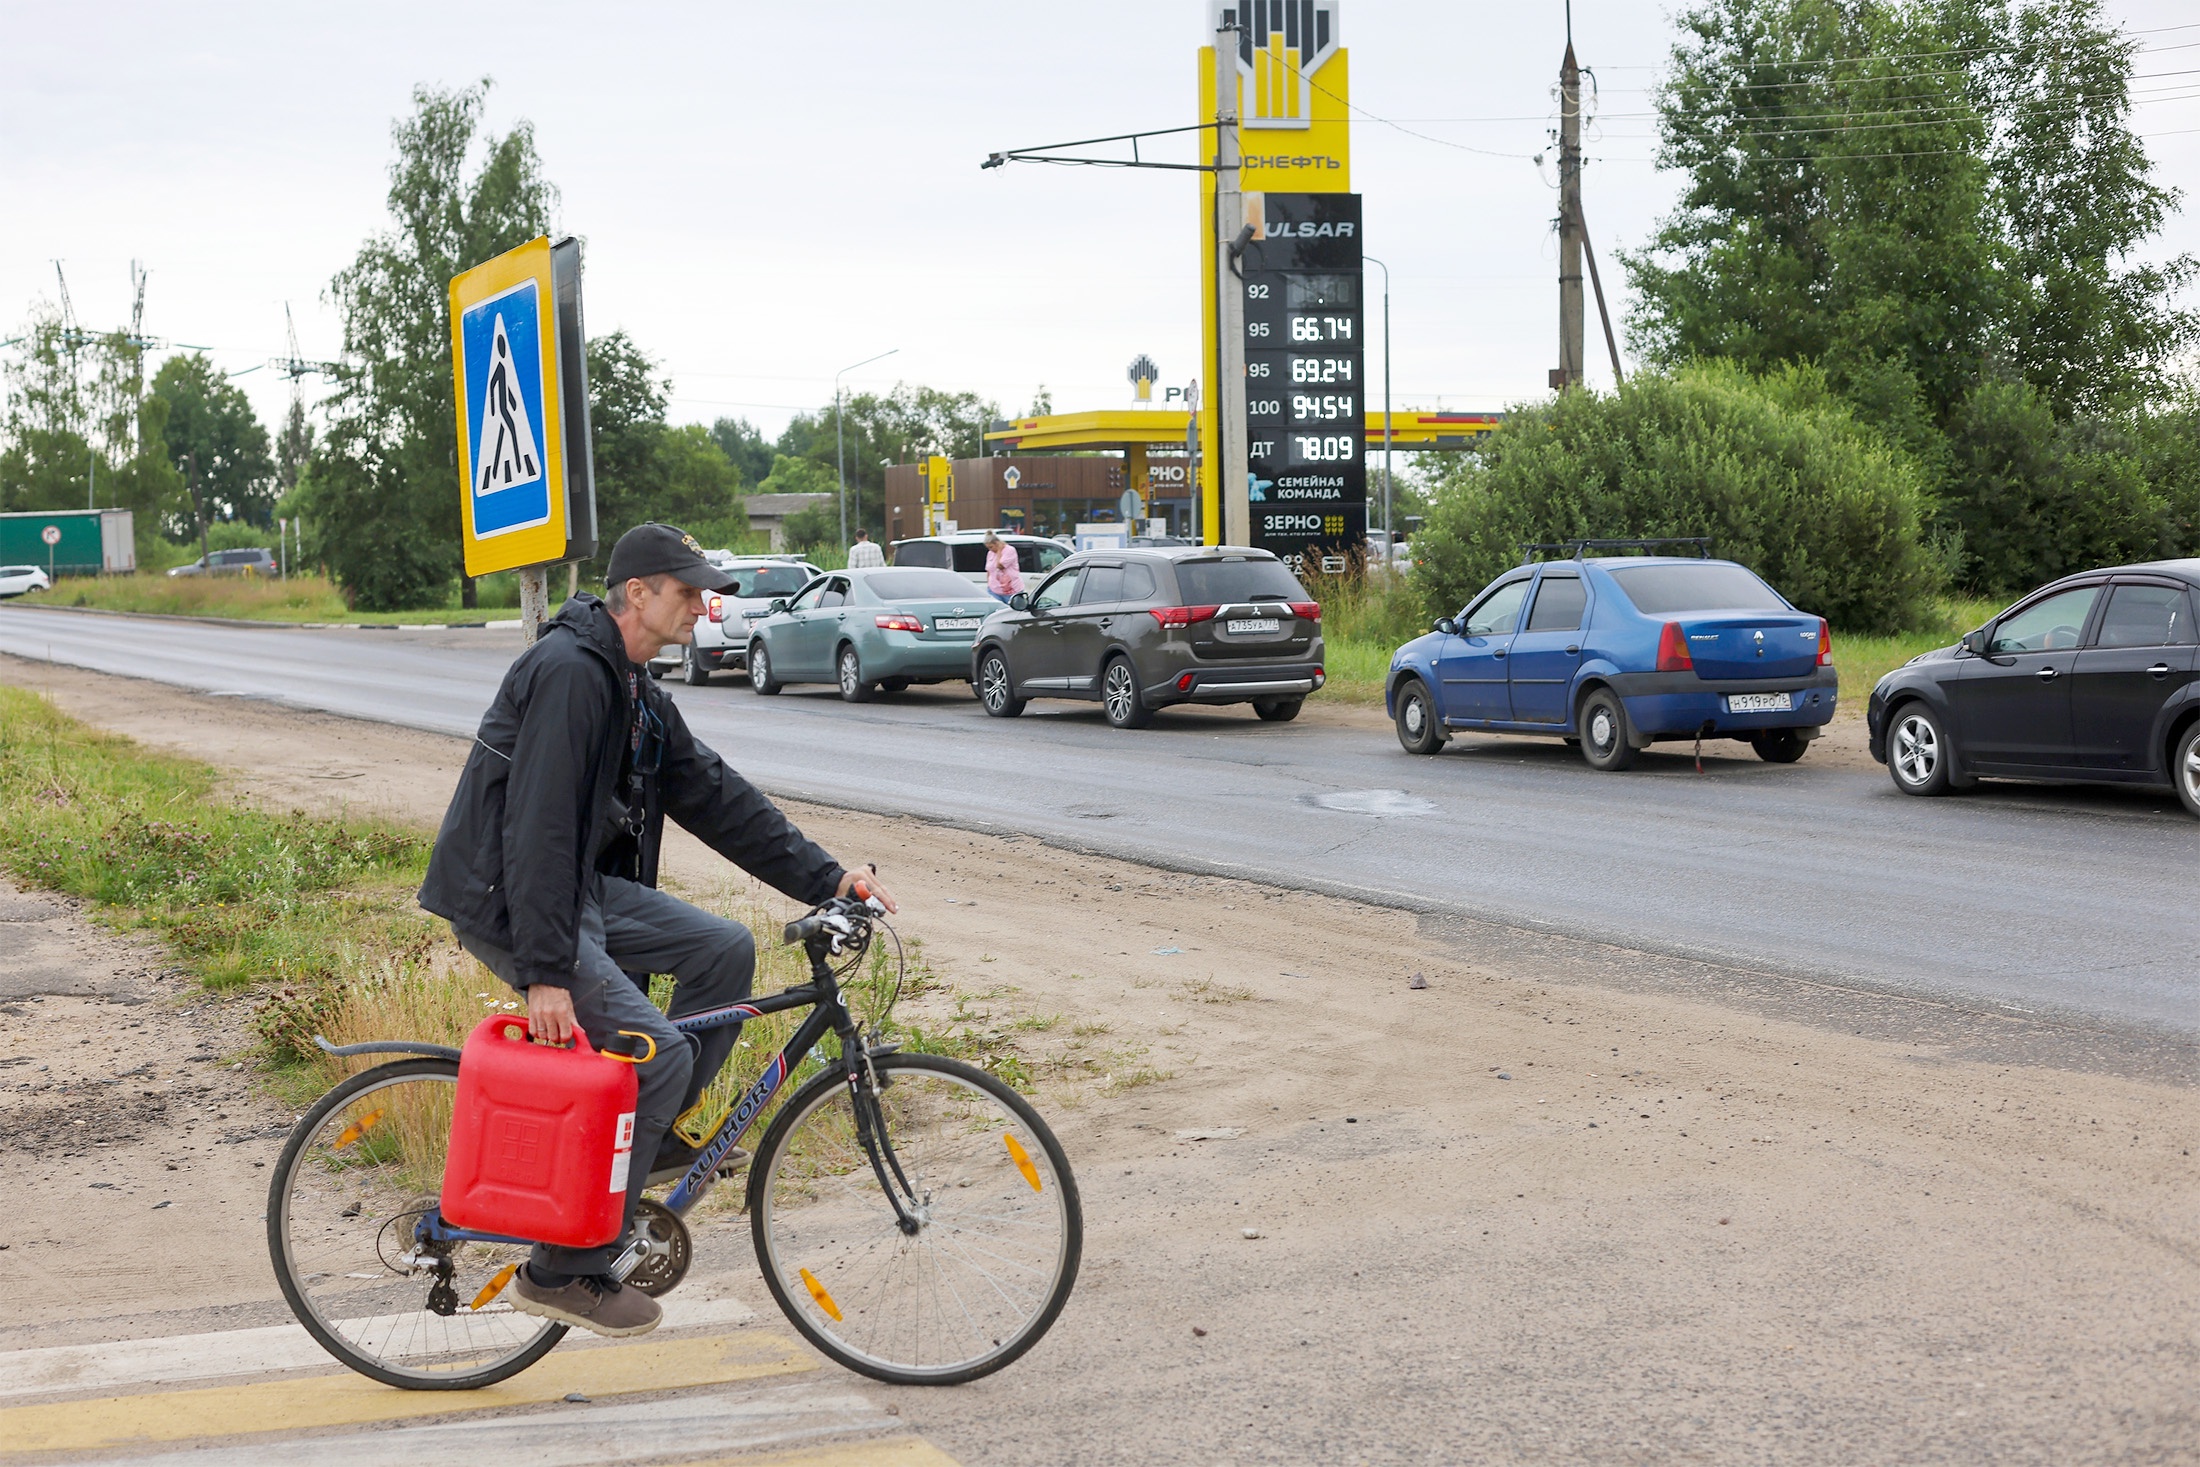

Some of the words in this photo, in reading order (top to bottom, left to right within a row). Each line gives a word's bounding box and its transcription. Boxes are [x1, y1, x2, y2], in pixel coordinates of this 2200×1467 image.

[1213, 155, 1341, 169] СНЕФТЬ
[1264, 222, 1355, 238] ULSAR
[1248, 284, 1269, 299] 92
[1249, 322, 1270, 337] 95
[1292, 317, 1352, 341] 66.74
[1248, 363, 1270, 378] 95
[1292, 359, 1352, 382] 69.24
[1249, 400, 1280, 415] 100
[1293, 395, 1352, 419] 94.54
[1250, 441, 1275, 459] ДТ
[1295, 436, 1353, 460] 78.09
[1149, 466, 1185, 481] РНО
[1277, 475, 1344, 487] СЕМЕЙНАЯ
[1277, 488, 1341, 499] КОМАНДА
[1264, 515, 1321, 530] ЗЕРНО
[686, 1080, 770, 1195] AUTHOR
